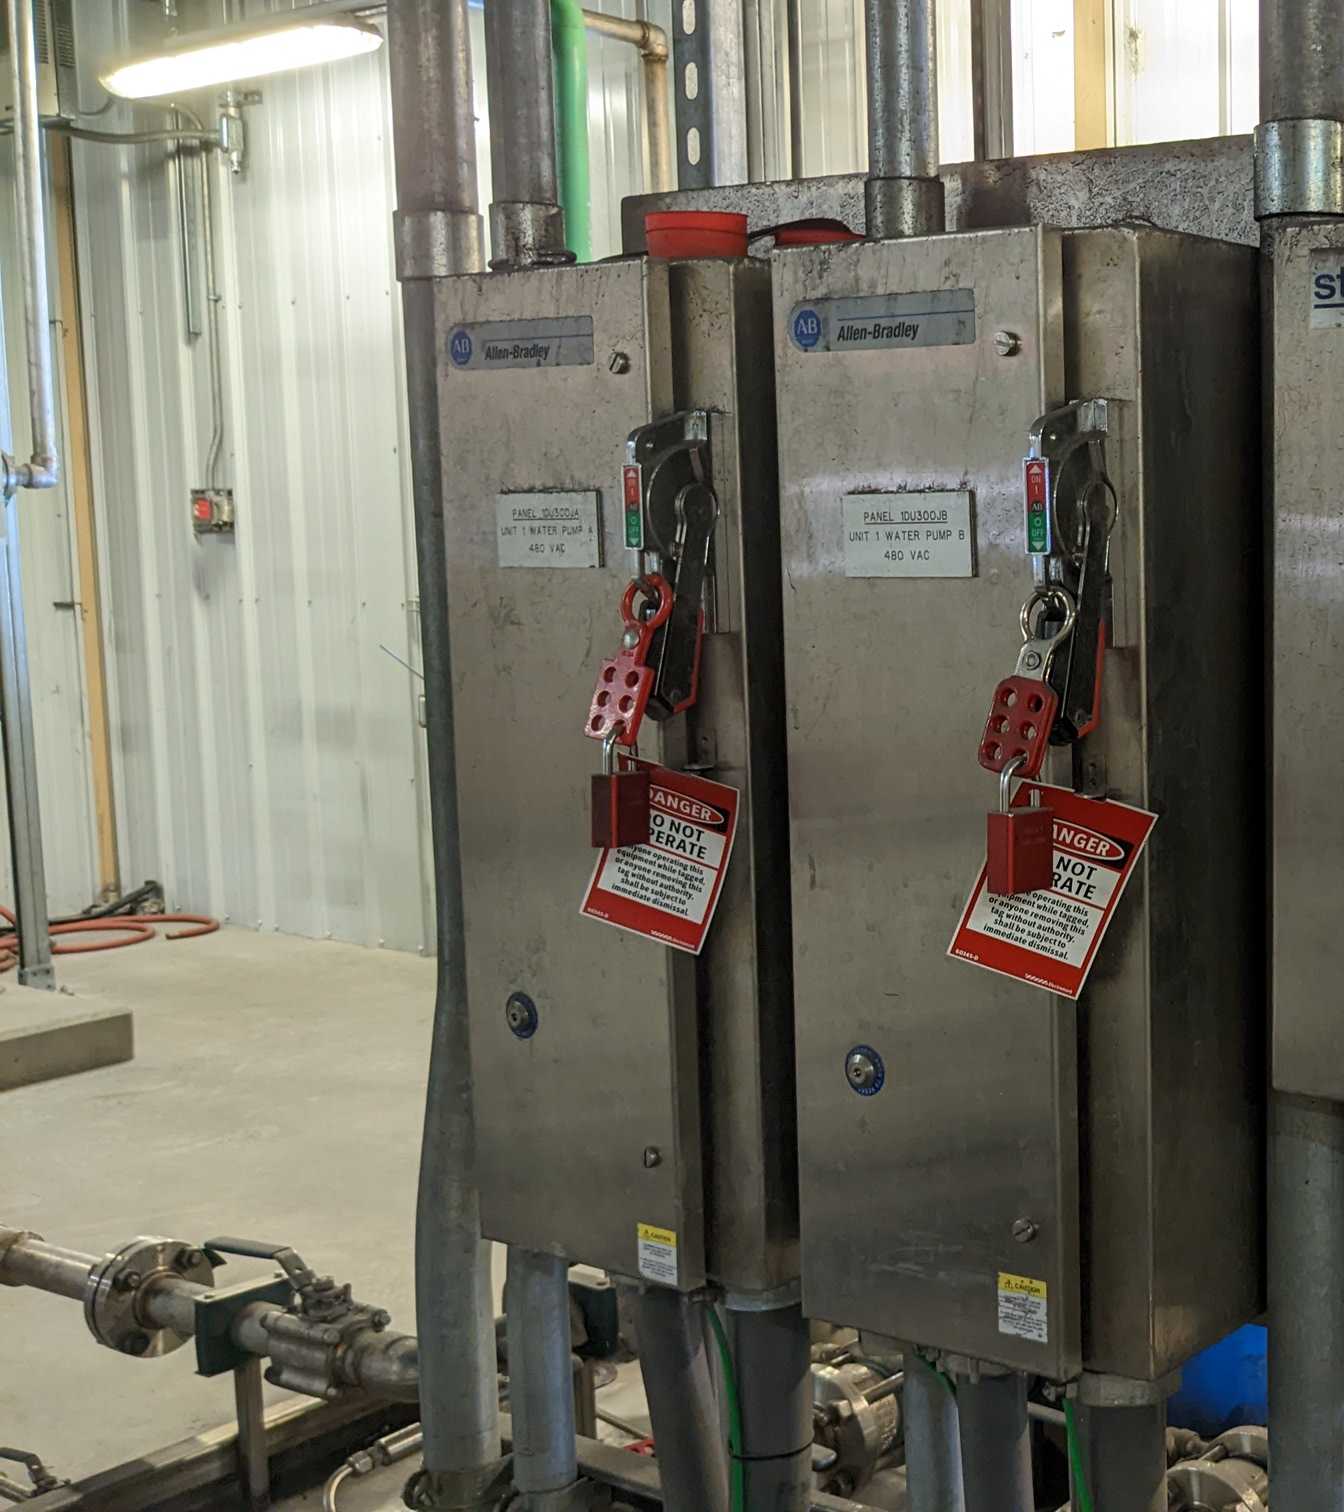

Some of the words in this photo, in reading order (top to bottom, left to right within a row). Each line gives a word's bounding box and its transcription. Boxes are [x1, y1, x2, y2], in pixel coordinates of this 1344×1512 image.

[797, 318, 818, 336] AB
[837, 322, 920, 342] Allen-Bradley
[453, 338, 470, 353] AB
[484, 344, 550, 361] Allen-Bradley
[512, 508, 537, 519] PANEL
[863, 511, 894, 521] PANEL
[501, 526, 517, 536] UNIT
[529, 526, 557, 536] WATER
[562, 525, 583, 536] PUMP
[849, 531, 869, 542] UNIT
[885, 530, 920, 541] WATER
[926, 529, 952, 540] PUMP
[958, 529, 965, 540] B
[528, 543, 545, 553] 480
[549, 543, 566, 553] VAC
[884, 550, 904, 561] 480
[910, 550, 930, 560] VAC
[652, 813, 665, 827] O
[668, 819, 705, 842] NOT
[648, 828, 707, 860] PERATE
[1053, 825, 1109, 857] NGER
[652, 852, 689, 871] operating
[689, 864, 703, 875] this
[1055, 855, 1097, 880] NOT
[630, 871, 659, 886] without
[1052, 872, 1096, 900] RATE
[620, 877, 640, 889] shall
[639, 883, 650, 892] be
[650, 888, 678, 903] subject
[678, 897, 686, 906] to
[1031, 891, 1072, 913] operating
[1072, 905, 1088, 917] this
[1036, 903, 1058, 916] while
[988, 896, 999, 904] or
[998, 899, 1030, 915] anyone
[1029, 911, 1069, 932] removing
[1069, 924, 1085, 935] this
[990, 905, 1005, 919] tag
[1005, 912, 1036, 928] without
[983, 923, 1027, 945] immediate
[993, 917, 1015, 930] shall
[1014, 924, 1026, 934] be
[1026, 930, 1057, 946] subject
[1057, 939, 1066, 949] to
